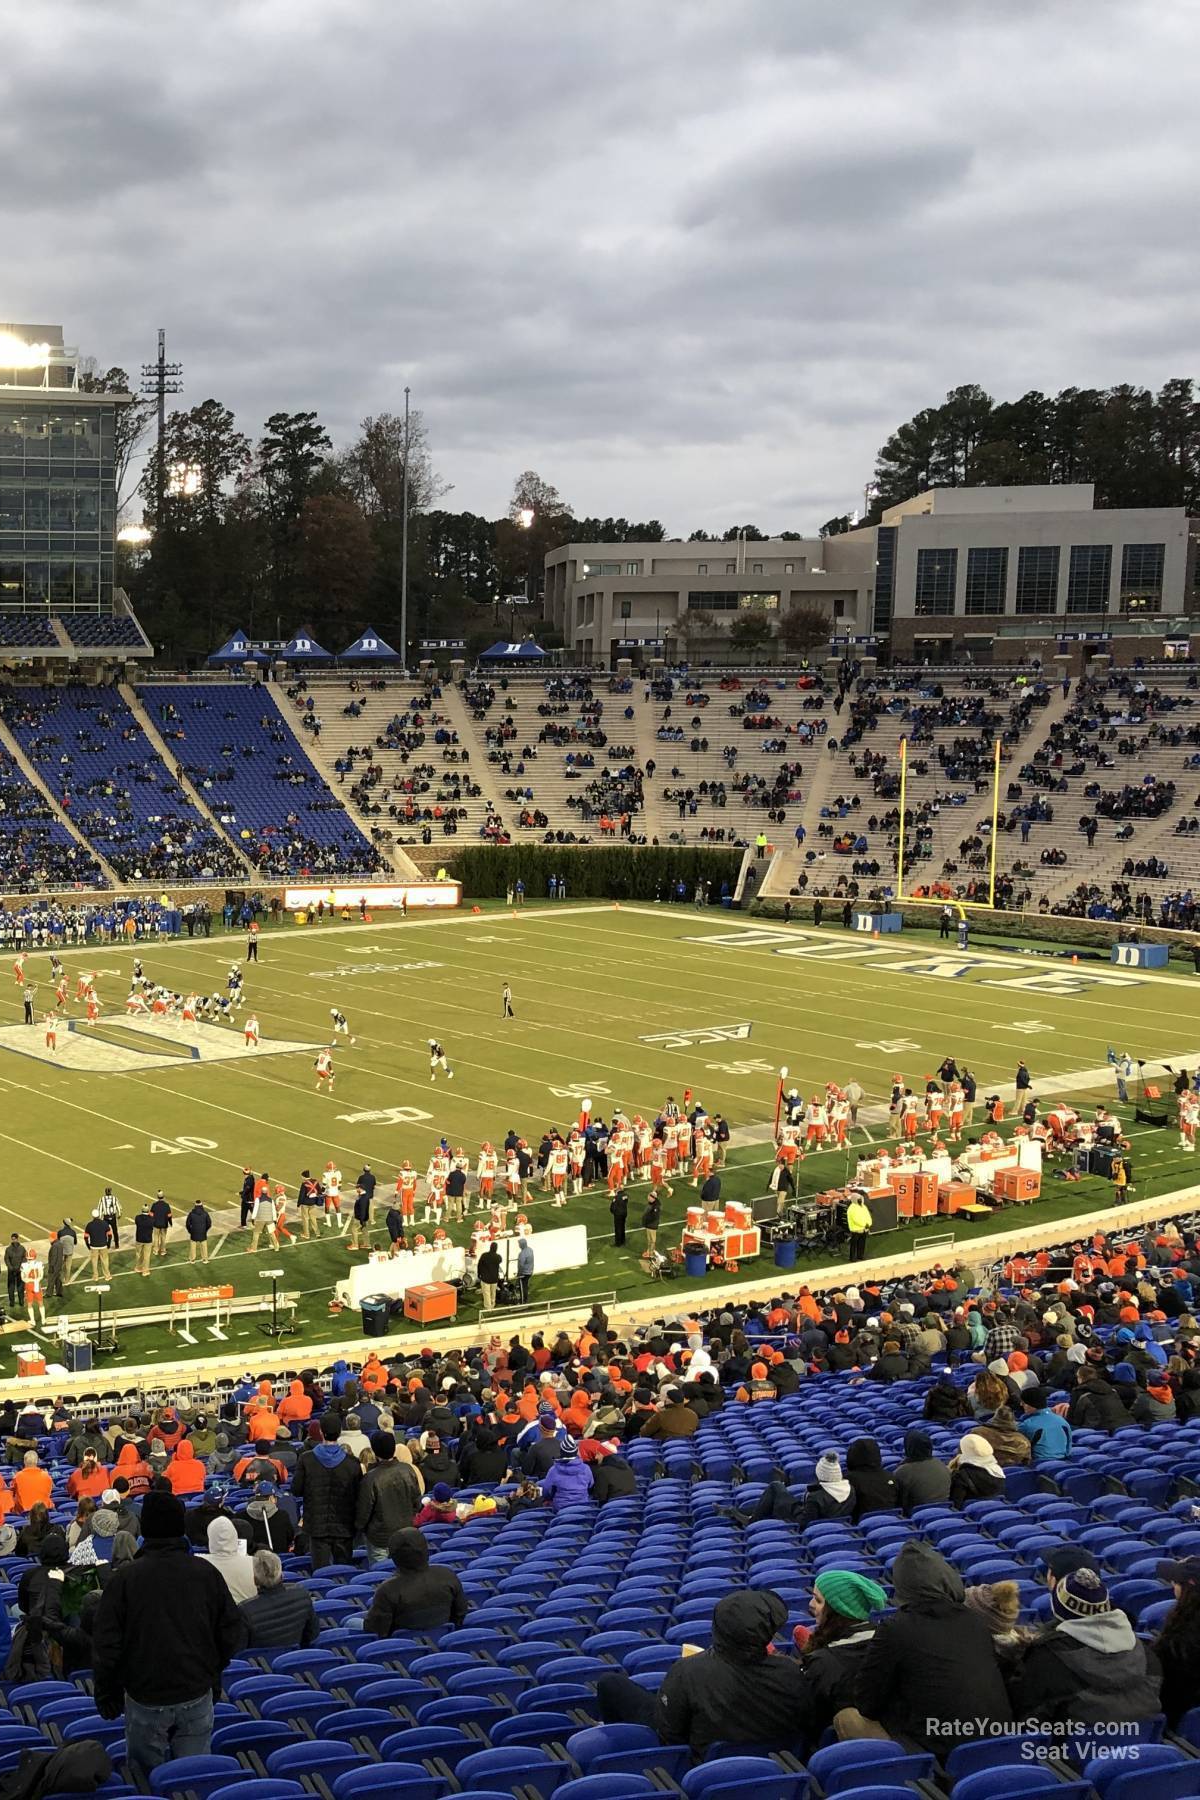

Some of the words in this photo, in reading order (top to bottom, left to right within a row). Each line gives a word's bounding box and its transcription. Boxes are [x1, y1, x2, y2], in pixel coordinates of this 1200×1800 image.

[856, 914, 873, 931] D
[681, 930, 1142, 995] DUKE
[1115, 946, 1140, 966] D
[638, 1022, 753, 1048] ACC
[150, 1136, 219, 1156] 40
[898, 1184, 907, 1194] S
[928, 1183, 935, 1193] S
